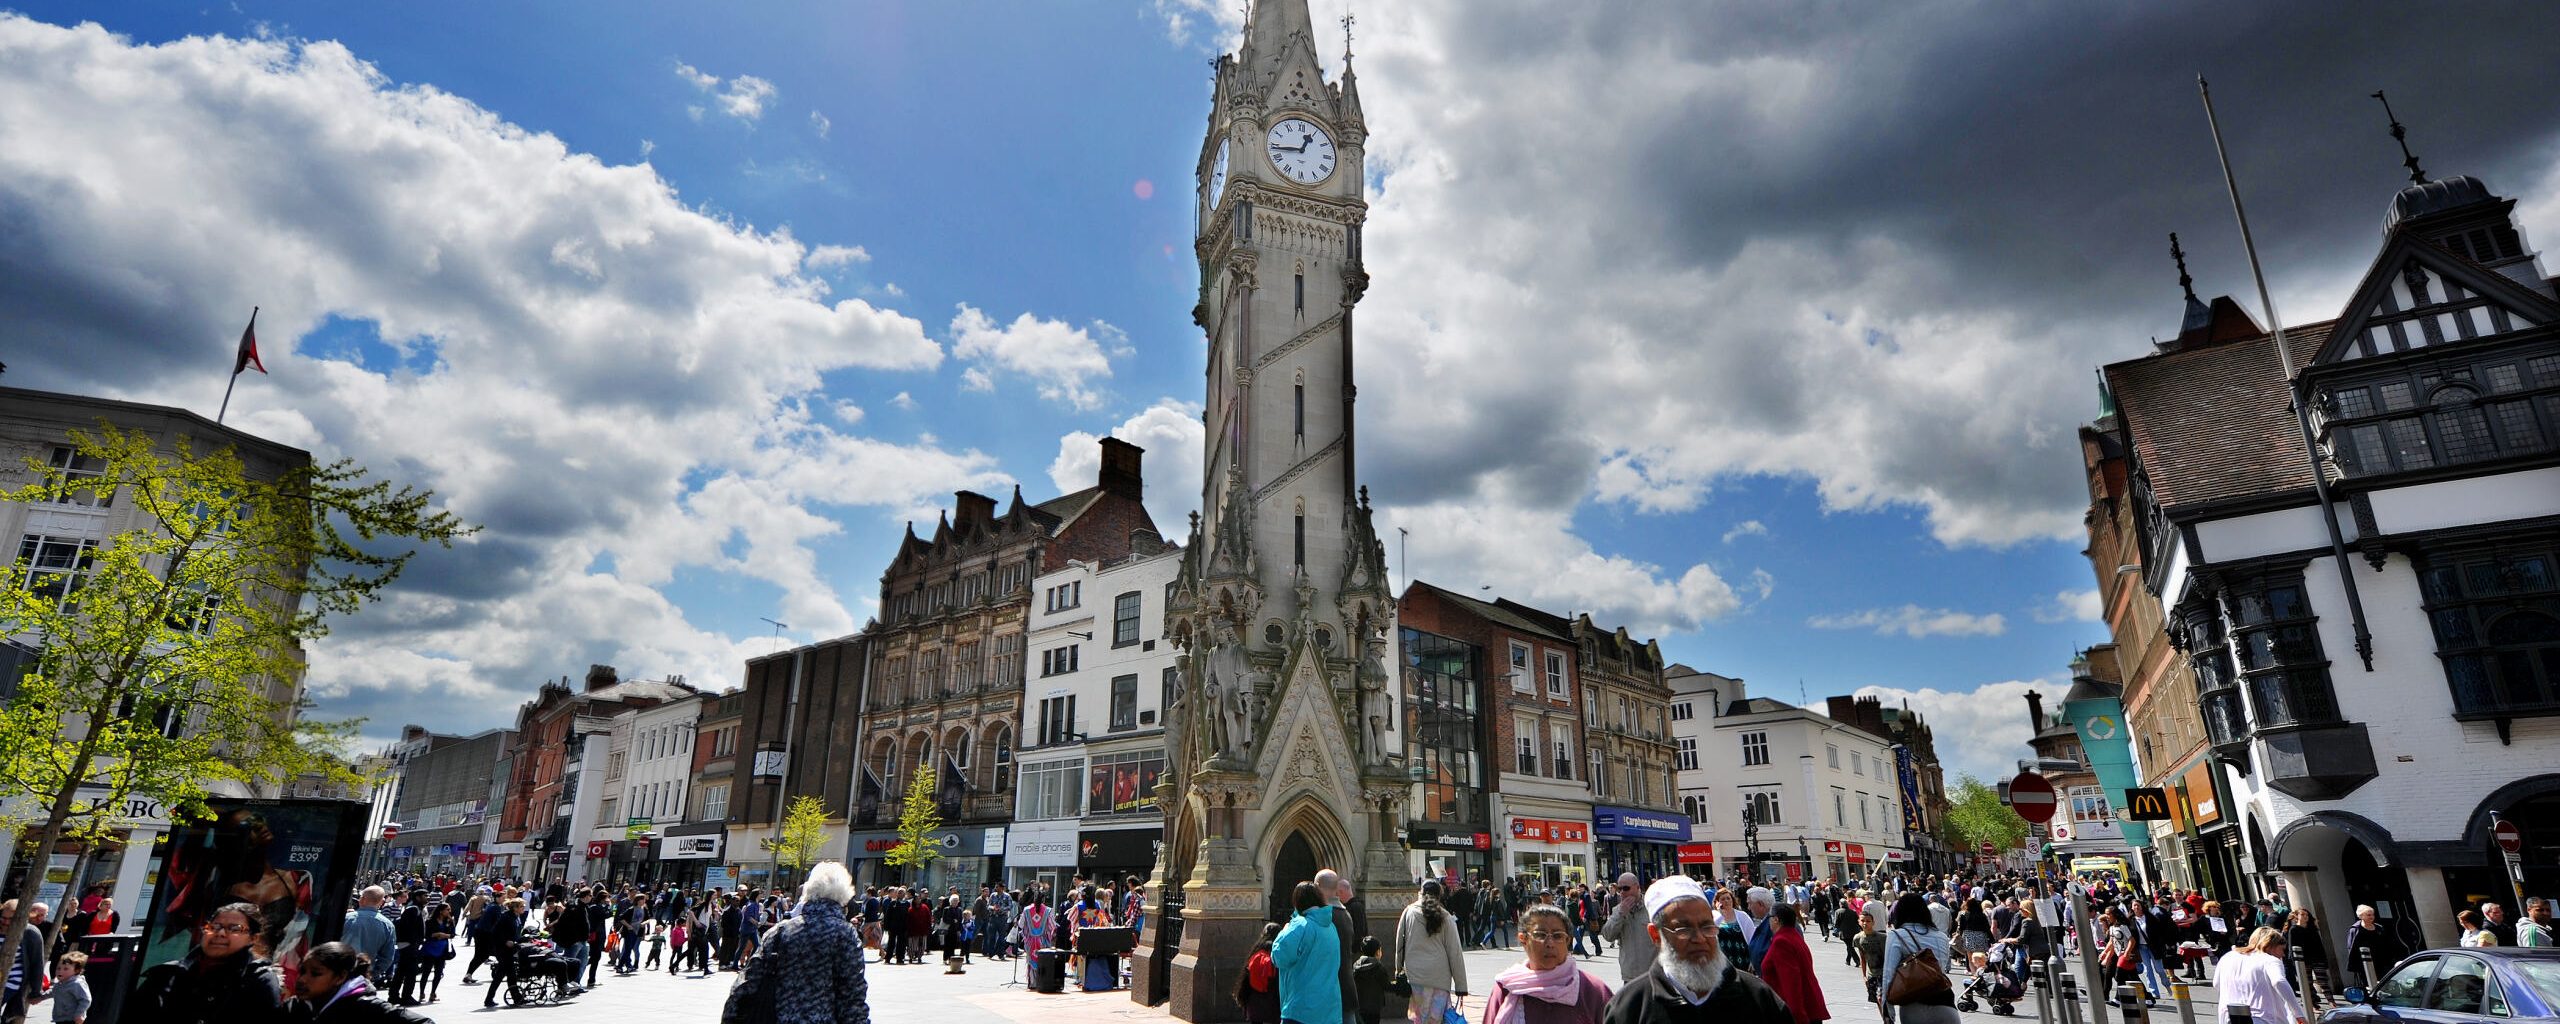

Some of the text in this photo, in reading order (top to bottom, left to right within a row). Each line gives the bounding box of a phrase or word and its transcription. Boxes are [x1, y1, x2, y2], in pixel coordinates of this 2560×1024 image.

[1625, 816, 1652, 829] Carphone
[1651, 819, 1680, 831] Warehouse
[1437, 834, 1474, 846] orthern rock
[1041, 843, 1072, 855] phones
[289, 853, 319, 862] £3.99
